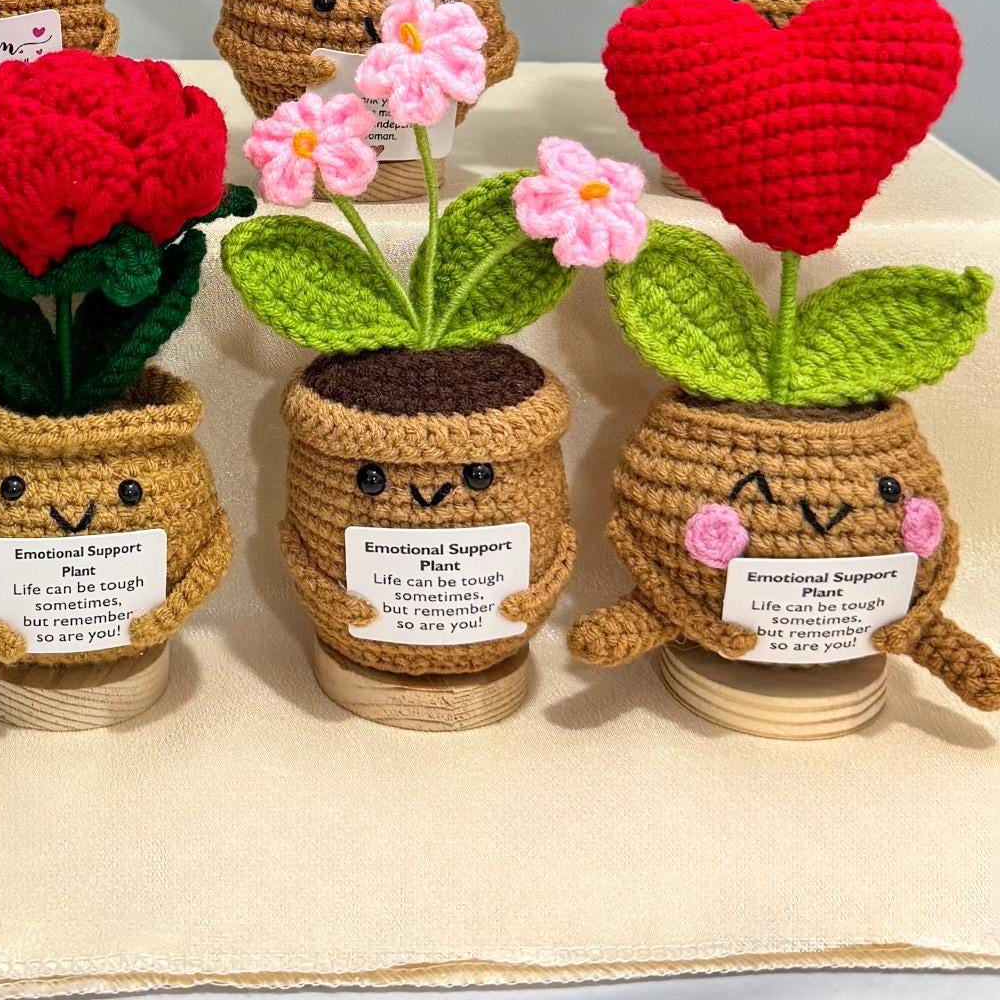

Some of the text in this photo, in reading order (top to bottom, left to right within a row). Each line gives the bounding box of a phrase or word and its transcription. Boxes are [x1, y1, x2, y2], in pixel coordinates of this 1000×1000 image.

[364, 133, 397, 141] oman.
[15, 542, 142, 560] Emotional Support
[365, 540, 513, 557] Emotional Support
[62, 566, 97, 578] Plant
[420, 560, 461, 572] Plant
[373, 572, 504, 588] Life can be tough
[747, 569, 898, 584] Emotional Support
[13, 576, 144, 596] Life can be tough
[801, 587, 844, 598] Plant
[35, 596, 122, 611] sometimes,
[382, 601, 495, 616] but remember
[751, 597, 885, 613] Life can be tough
[23, 611, 134, 627] but remember
[397, 616, 482, 633] so are you!
[36, 625, 121, 643] so are you!
[756, 624, 872, 639] but remember
[769, 637, 857, 653] so are you!
